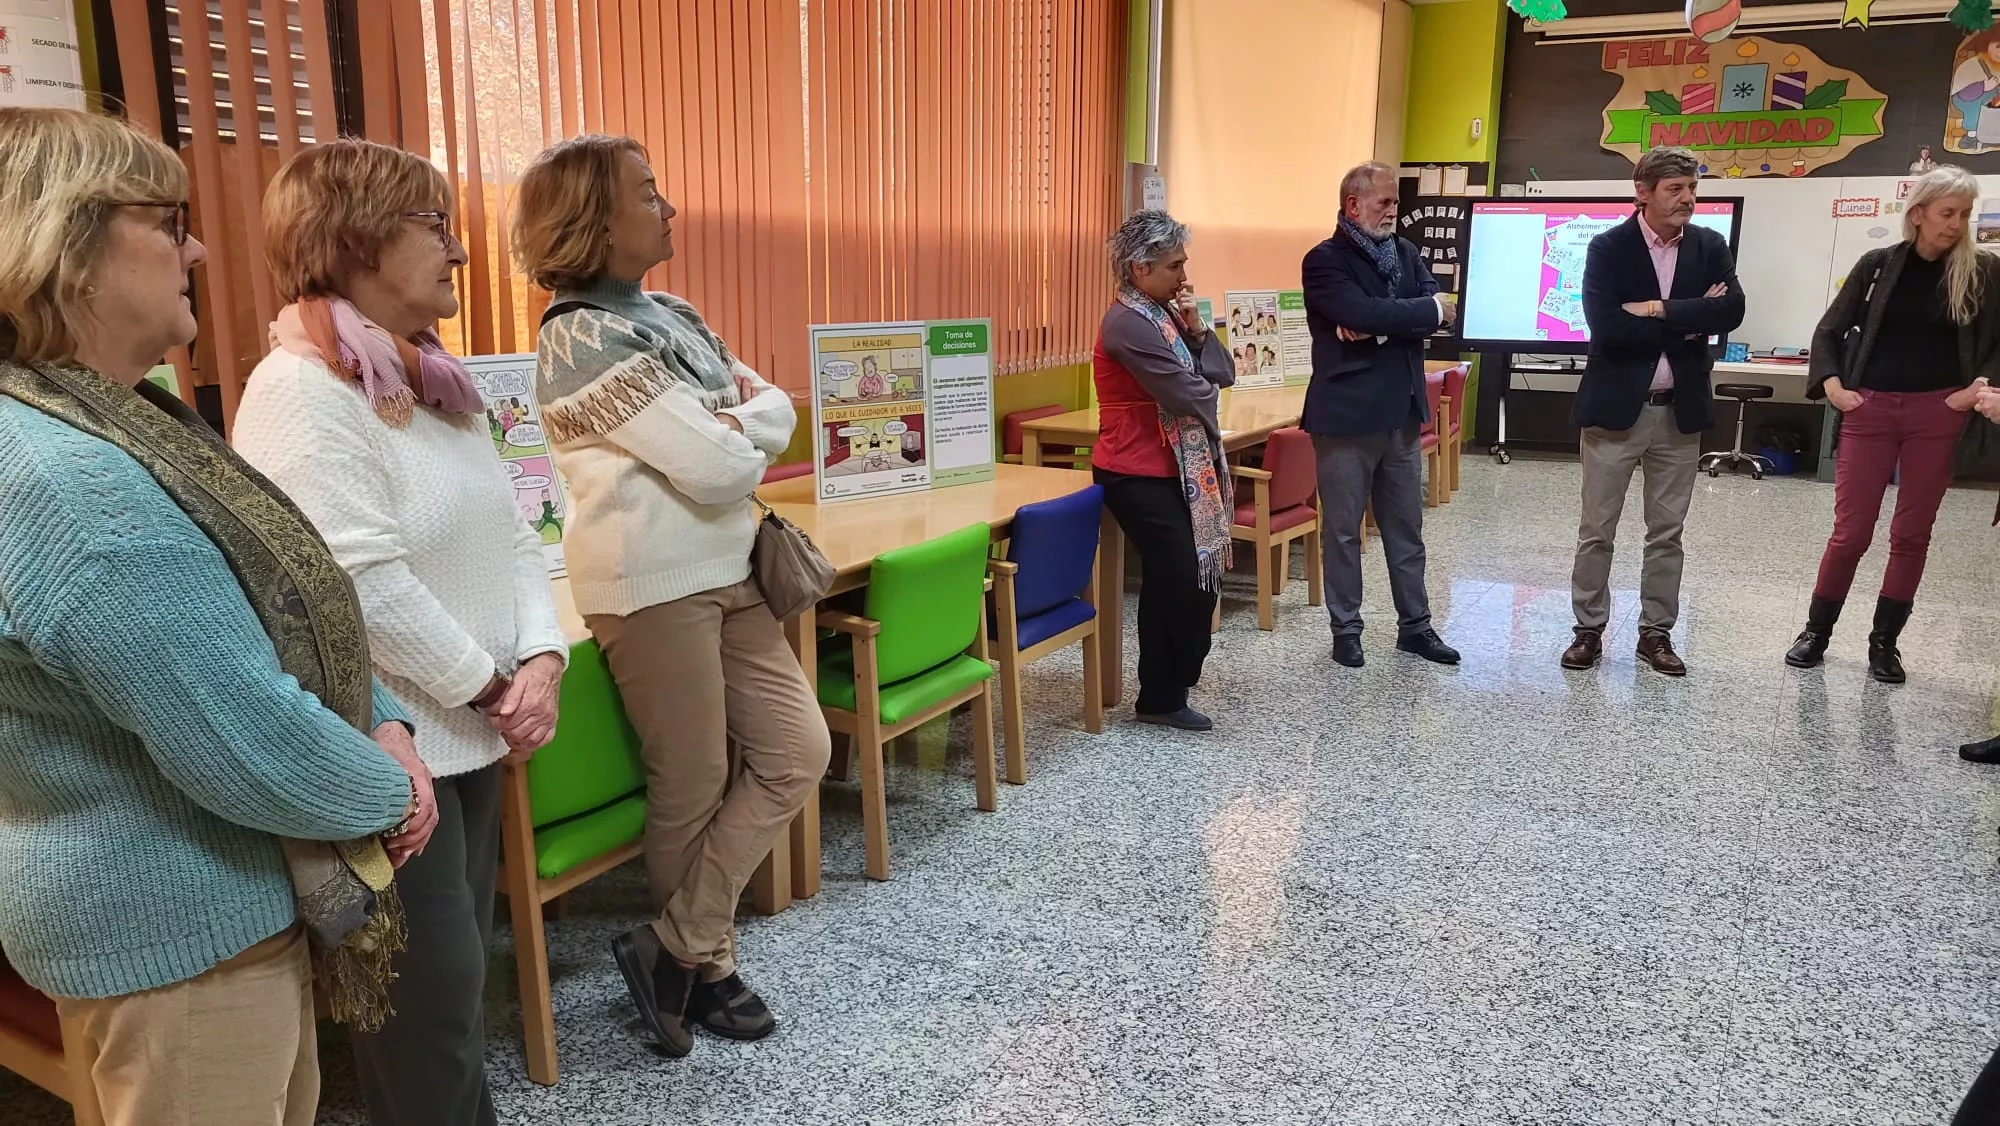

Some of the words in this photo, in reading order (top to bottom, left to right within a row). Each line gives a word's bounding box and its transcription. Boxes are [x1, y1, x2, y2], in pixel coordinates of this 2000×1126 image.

[31, 39, 58, 47] SECADO
[1604, 39, 1710, 69] FELIZ
[25, 78, 57, 87] LIMPIEZA
[1649, 118, 1835, 148] NAVIDAD
[1840, 200, 1872, 213] Lunes
[1426, 229, 1456, 237] DEL
[1422, 247, 1456, 257] MES
[945, 331, 964, 339] Toma
[862, 339, 892, 347] REALIDAD
[942, 341, 977, 350] decisiones
[858, 408, 888, 416] CUIDADOR
[904, 404, 922, 412] VECES
